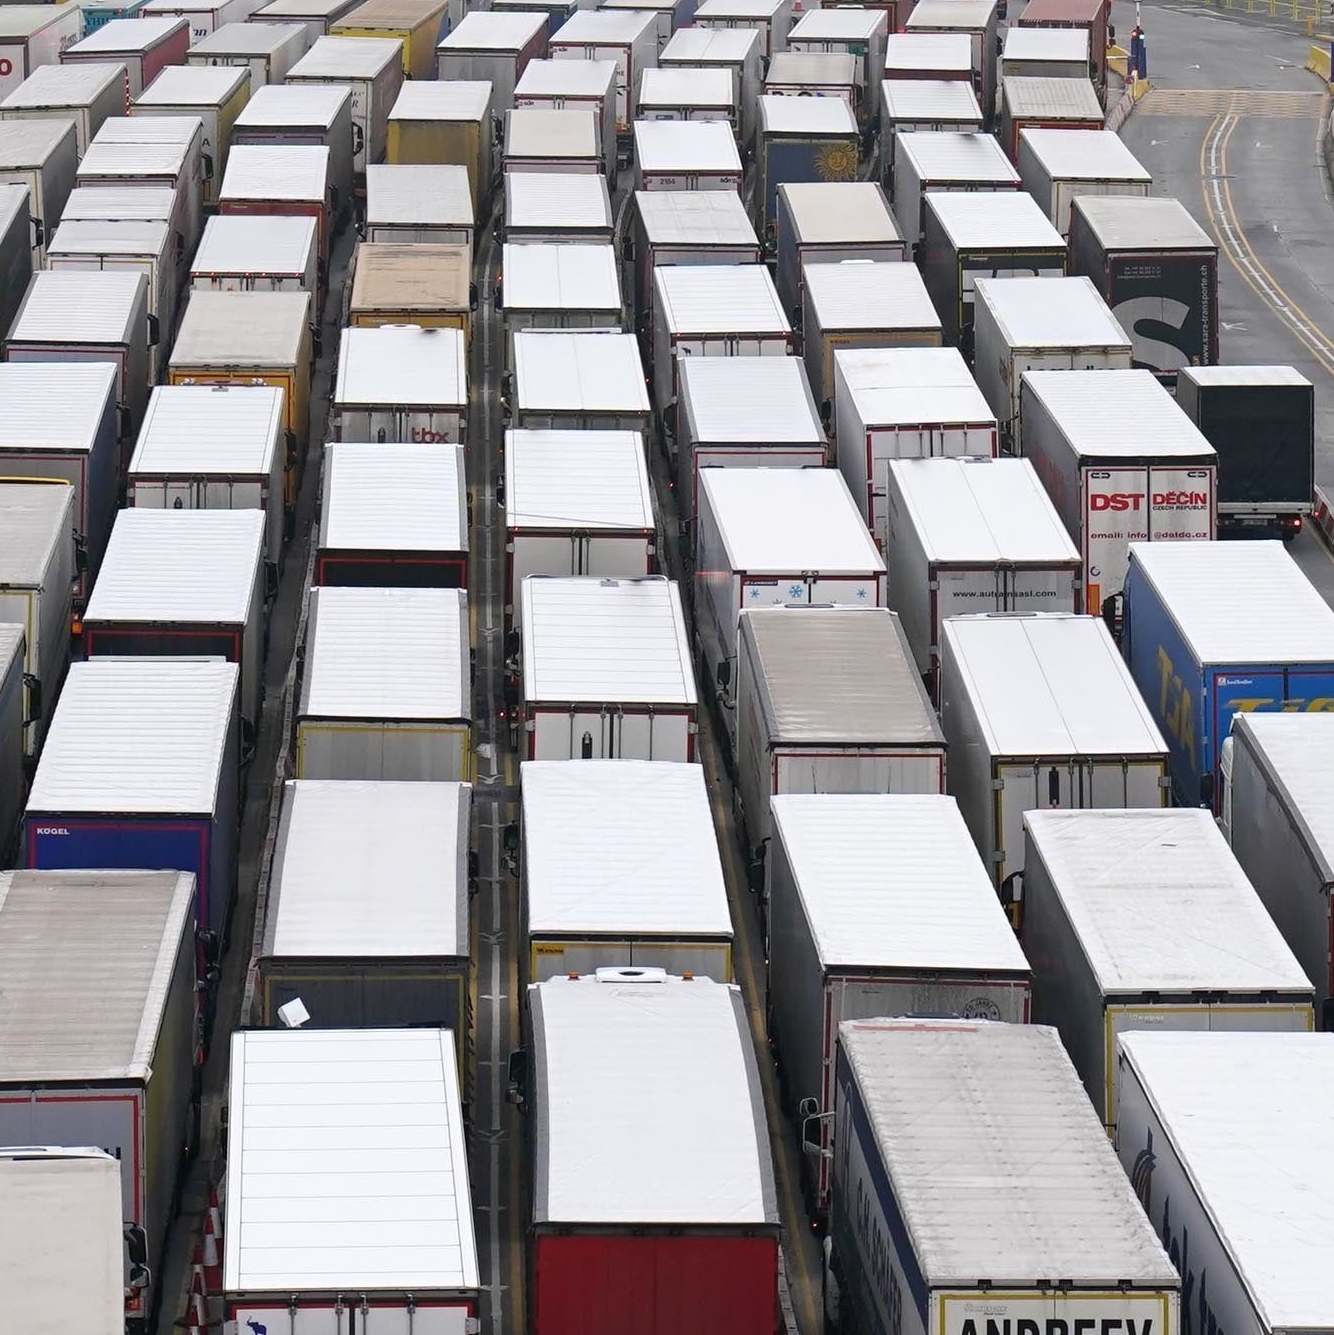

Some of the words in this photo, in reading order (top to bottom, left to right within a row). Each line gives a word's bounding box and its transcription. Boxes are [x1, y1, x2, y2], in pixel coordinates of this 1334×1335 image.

[411, 427, 449, 444] tbx
[1091, 494, 1145, 512] DST
[1153, 491, 1207, 505] DĚČÍN
[961, 1318, 1153, 1335] ANDREEV
